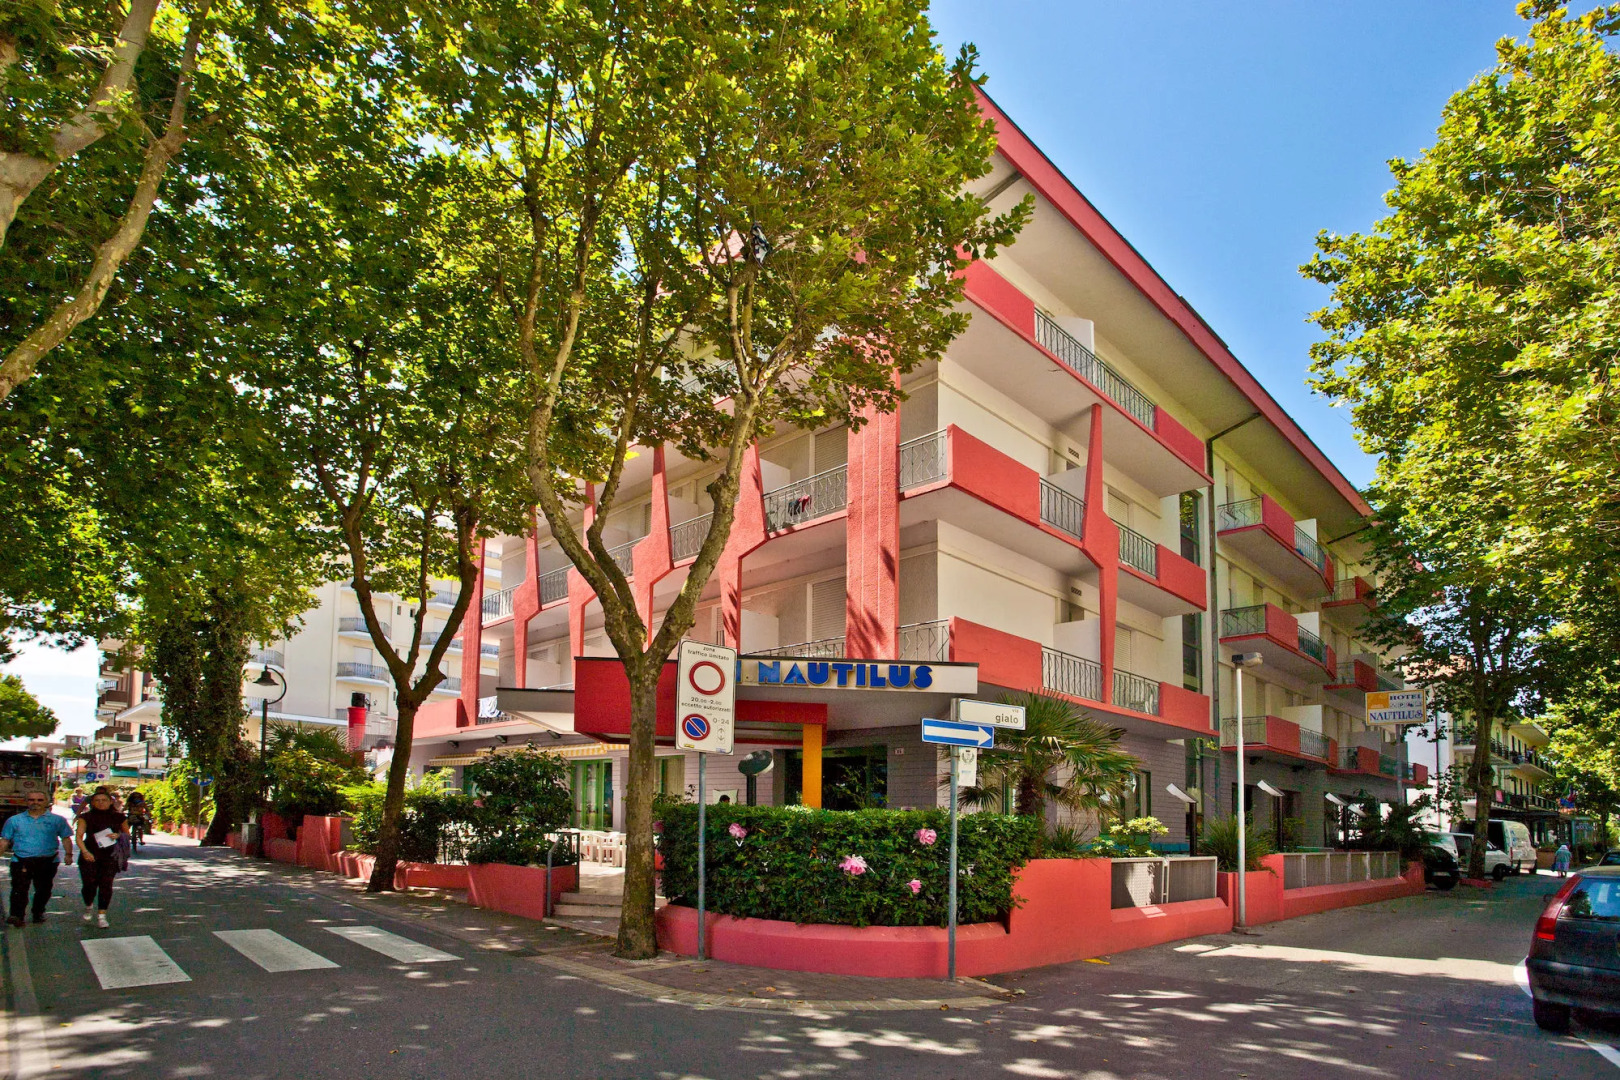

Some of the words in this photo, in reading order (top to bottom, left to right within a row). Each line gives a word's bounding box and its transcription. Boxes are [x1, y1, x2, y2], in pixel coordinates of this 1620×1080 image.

[687, 649, 708, 657] traffico
[708, 653, 730, 661] limitato
[758, 660, 933, 689] NAUTILUS
[1389, 693, 1422, 701] HOTEL
[703, 705, 731, 713] autorizzati
[995, 713, 1019, 724] gialo
[1369, 709, 1423, 721] NAUTILUS
